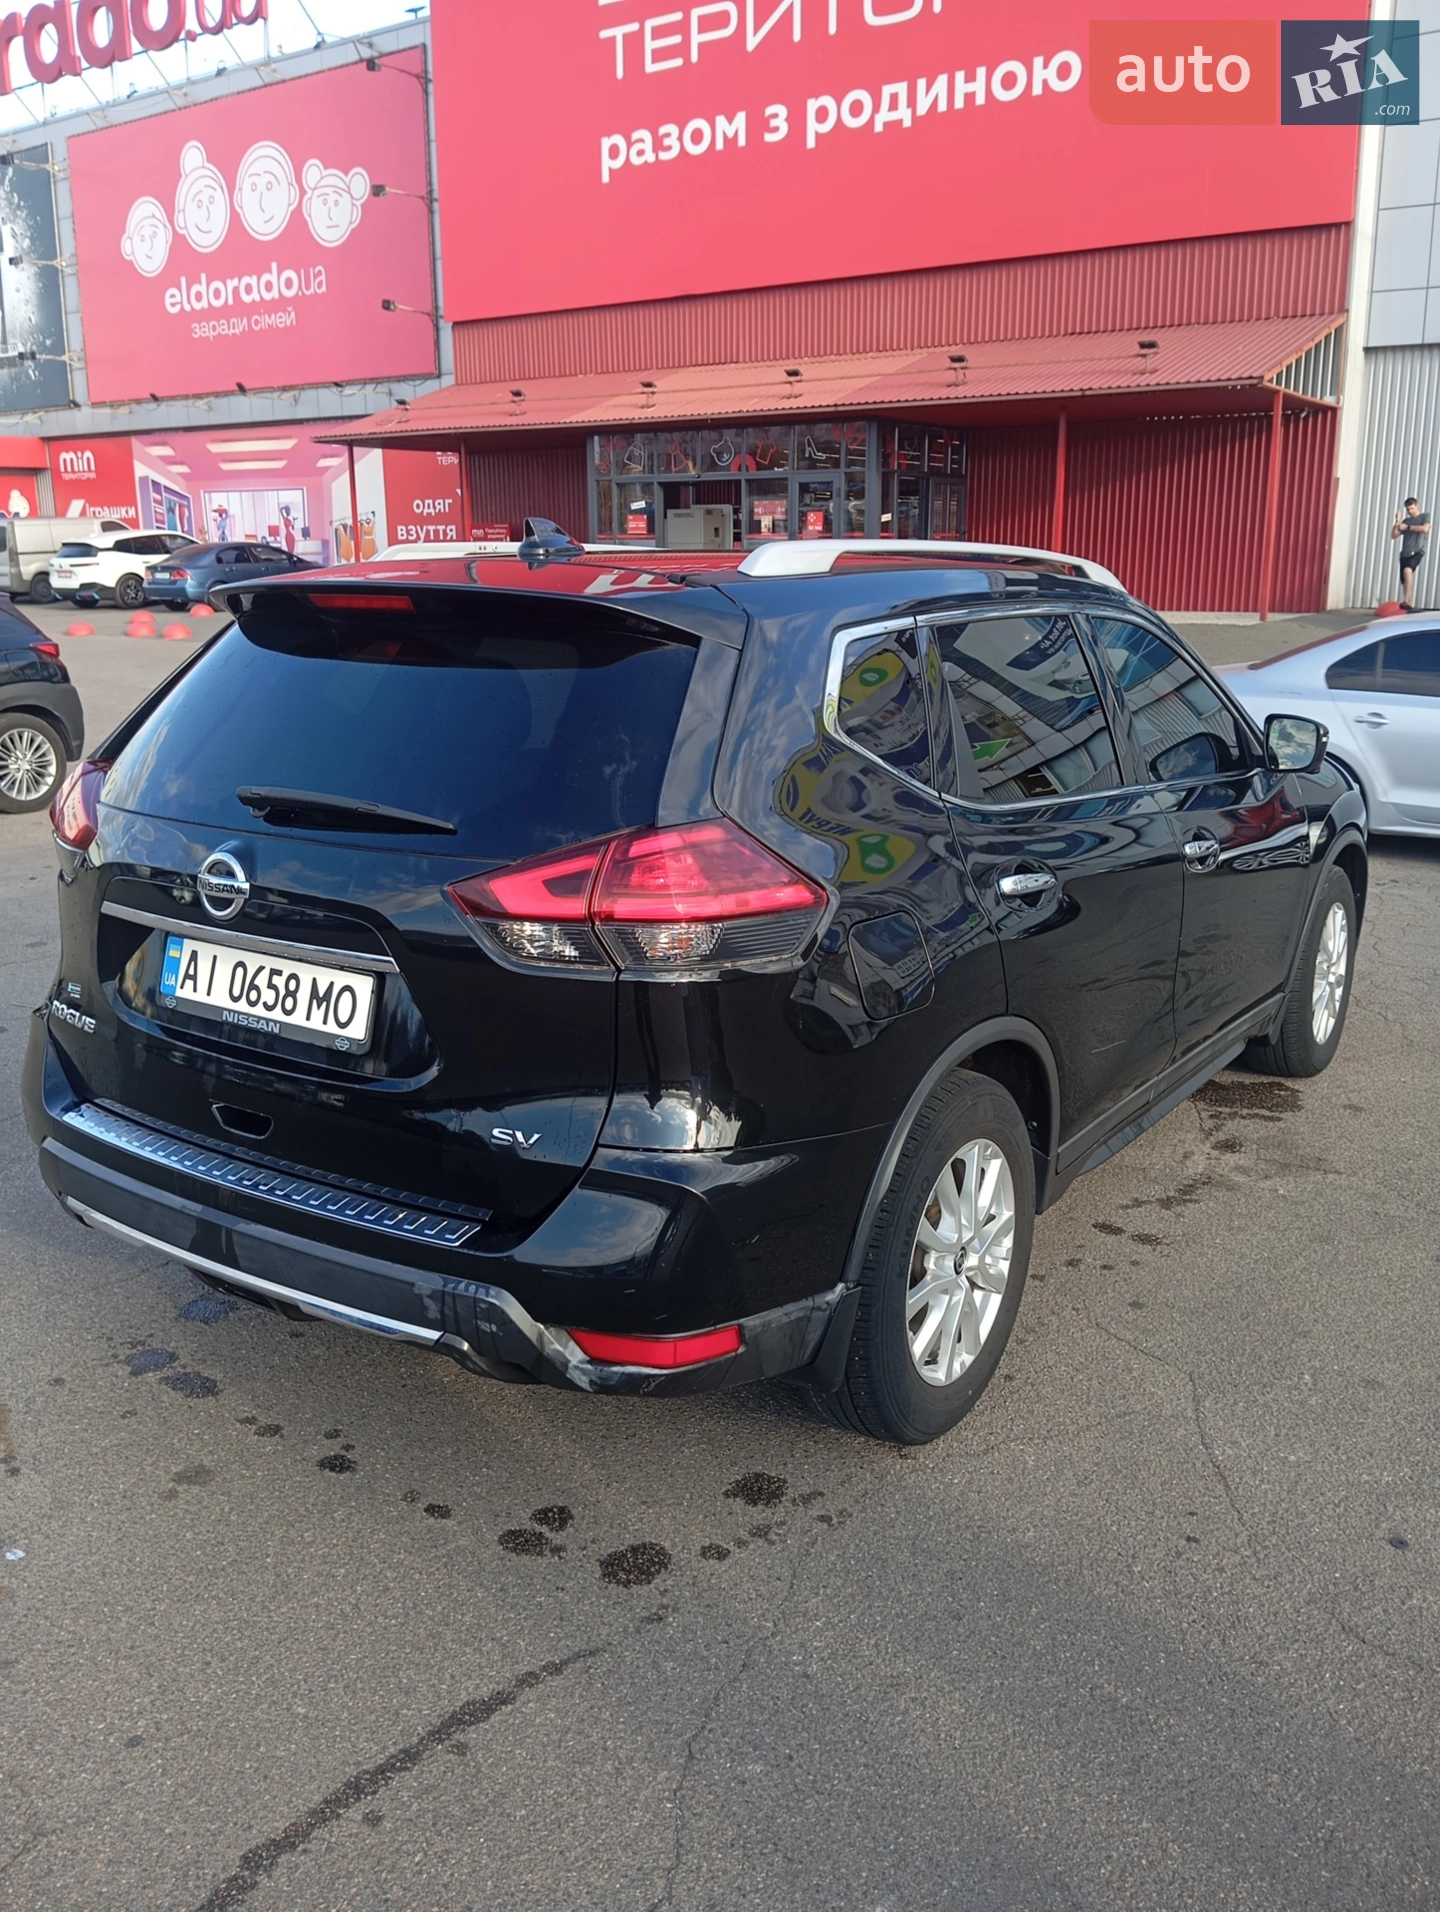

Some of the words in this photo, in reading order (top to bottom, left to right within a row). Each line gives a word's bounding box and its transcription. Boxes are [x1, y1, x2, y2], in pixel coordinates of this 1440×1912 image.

[599, 0, 942, 80] ТЕРИ
[600, 110, 747, 184] разом
[763, 103, 789, 143] з
[806, 49, 1083, 149] родиною
[164, 261, 327, 314] eldorado.ua
[191, 316, 249, 341] заради
[251, 306, 296, 332] сімей
[199, 878, 240, 896] NISSAN
[164, 972, 177, 988] UA
[228, 960, 301, 1017] 0658
[52, 1000, 97, 1034] ROGUE
[221, 1010, 281, 1034] NISSAN
[490, 1127, 542, 1149] SV
